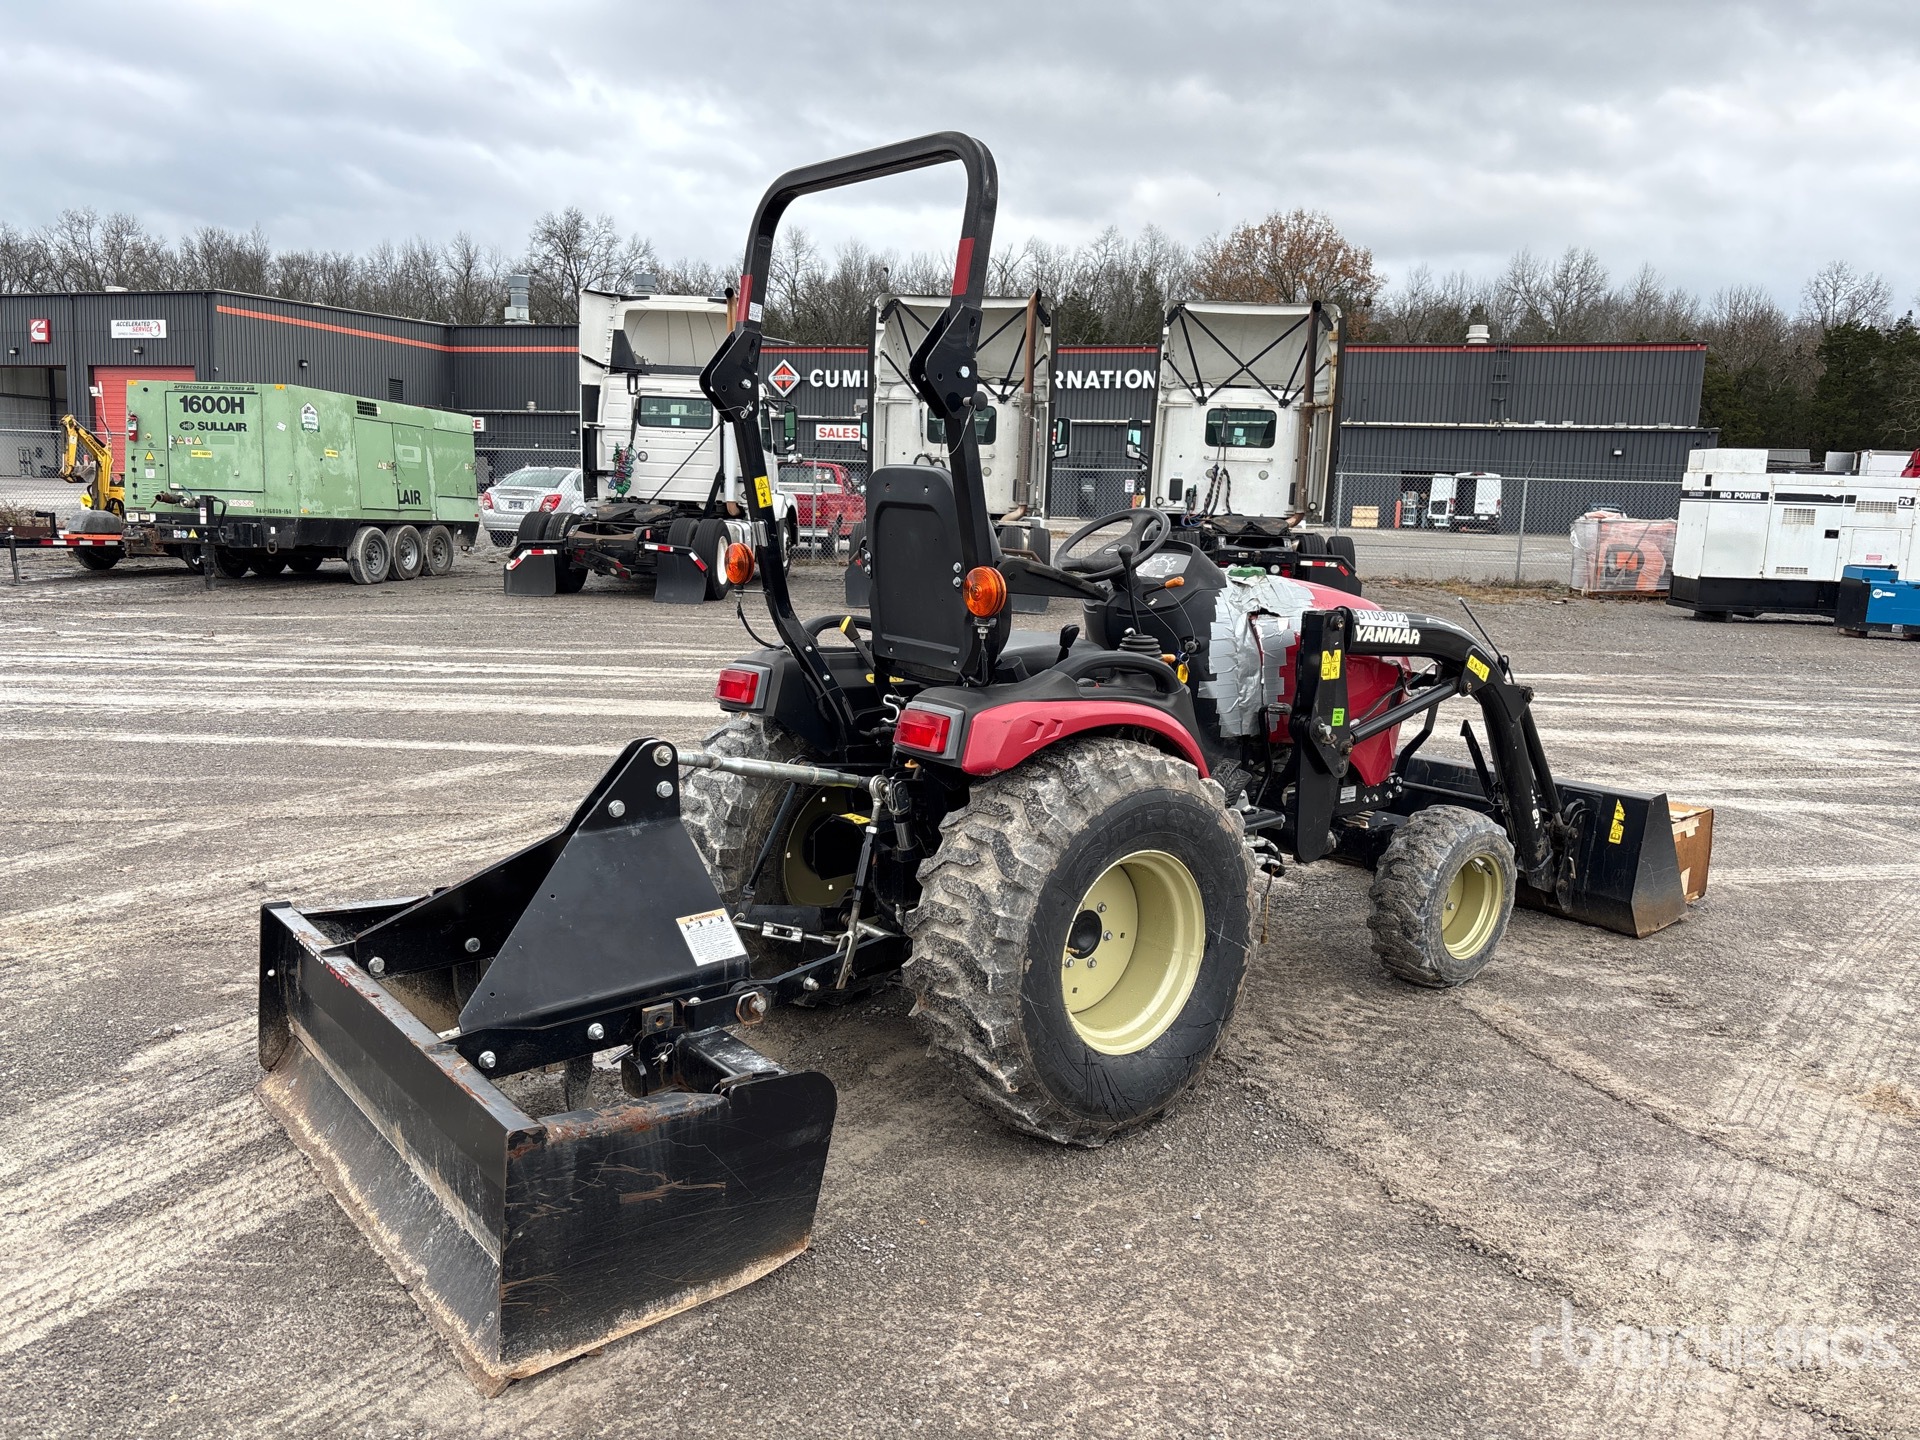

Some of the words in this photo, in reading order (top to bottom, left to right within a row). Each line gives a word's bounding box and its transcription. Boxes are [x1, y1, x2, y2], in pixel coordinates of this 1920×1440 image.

[179, 395, 245, 415] 1600H
[197, 421, 247, 432] SULLAIR
[818, 427, 860, 439] SALES
[1355, 625, 1421, 645] YANMAR
